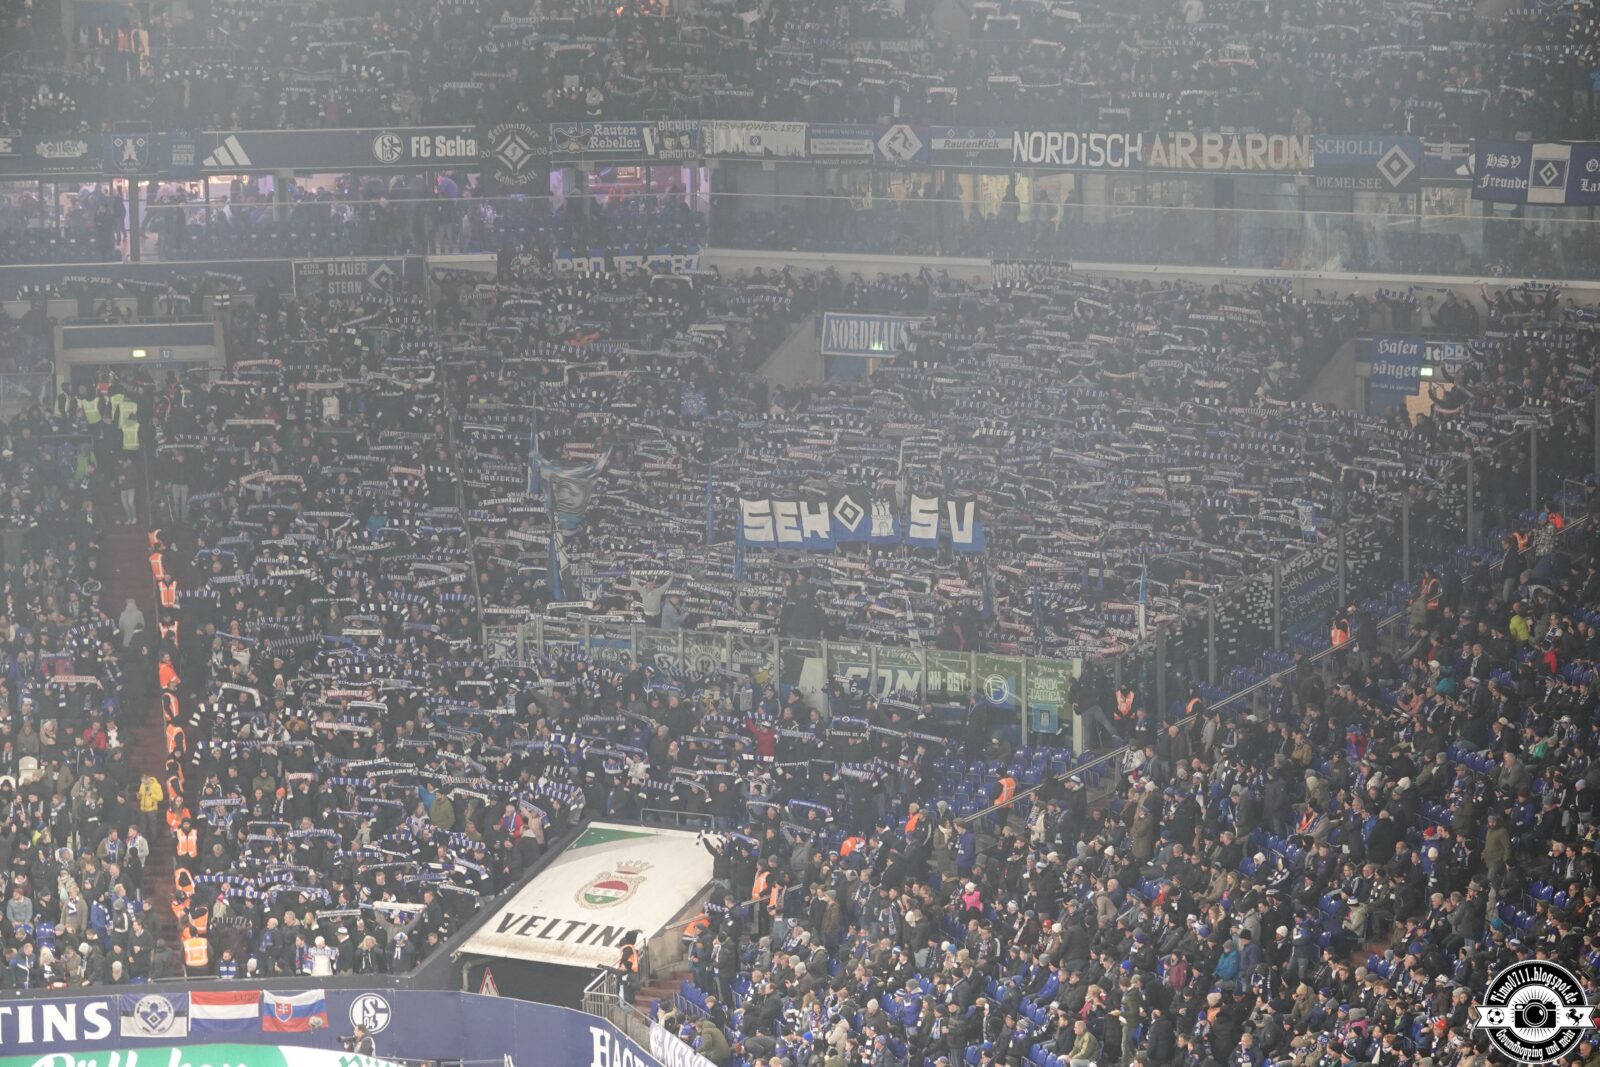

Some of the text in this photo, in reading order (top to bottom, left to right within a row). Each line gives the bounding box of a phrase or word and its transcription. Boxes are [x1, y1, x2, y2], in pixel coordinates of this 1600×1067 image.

[593, 124, 637, 136] Rauten
[411, 136, 430, 157] FC
[590, 137, 641, 149] Rebellen
[944, 139, 999, 149] RautenKick
[1315, 139, 1383, 155] SCHOLLI
[1485, 153, 1521, 169] HSV
[1316, 176, 1382, 190] DIEMELSEE
[1477, 174, 1528, 190] Freunde
[328, 263, 367, 275] BLAUER
[328, 281, 362, 294] STERN
[1280, 567, 1320, 594] Sektion
[495, 912, 630, 948] VELTIN
